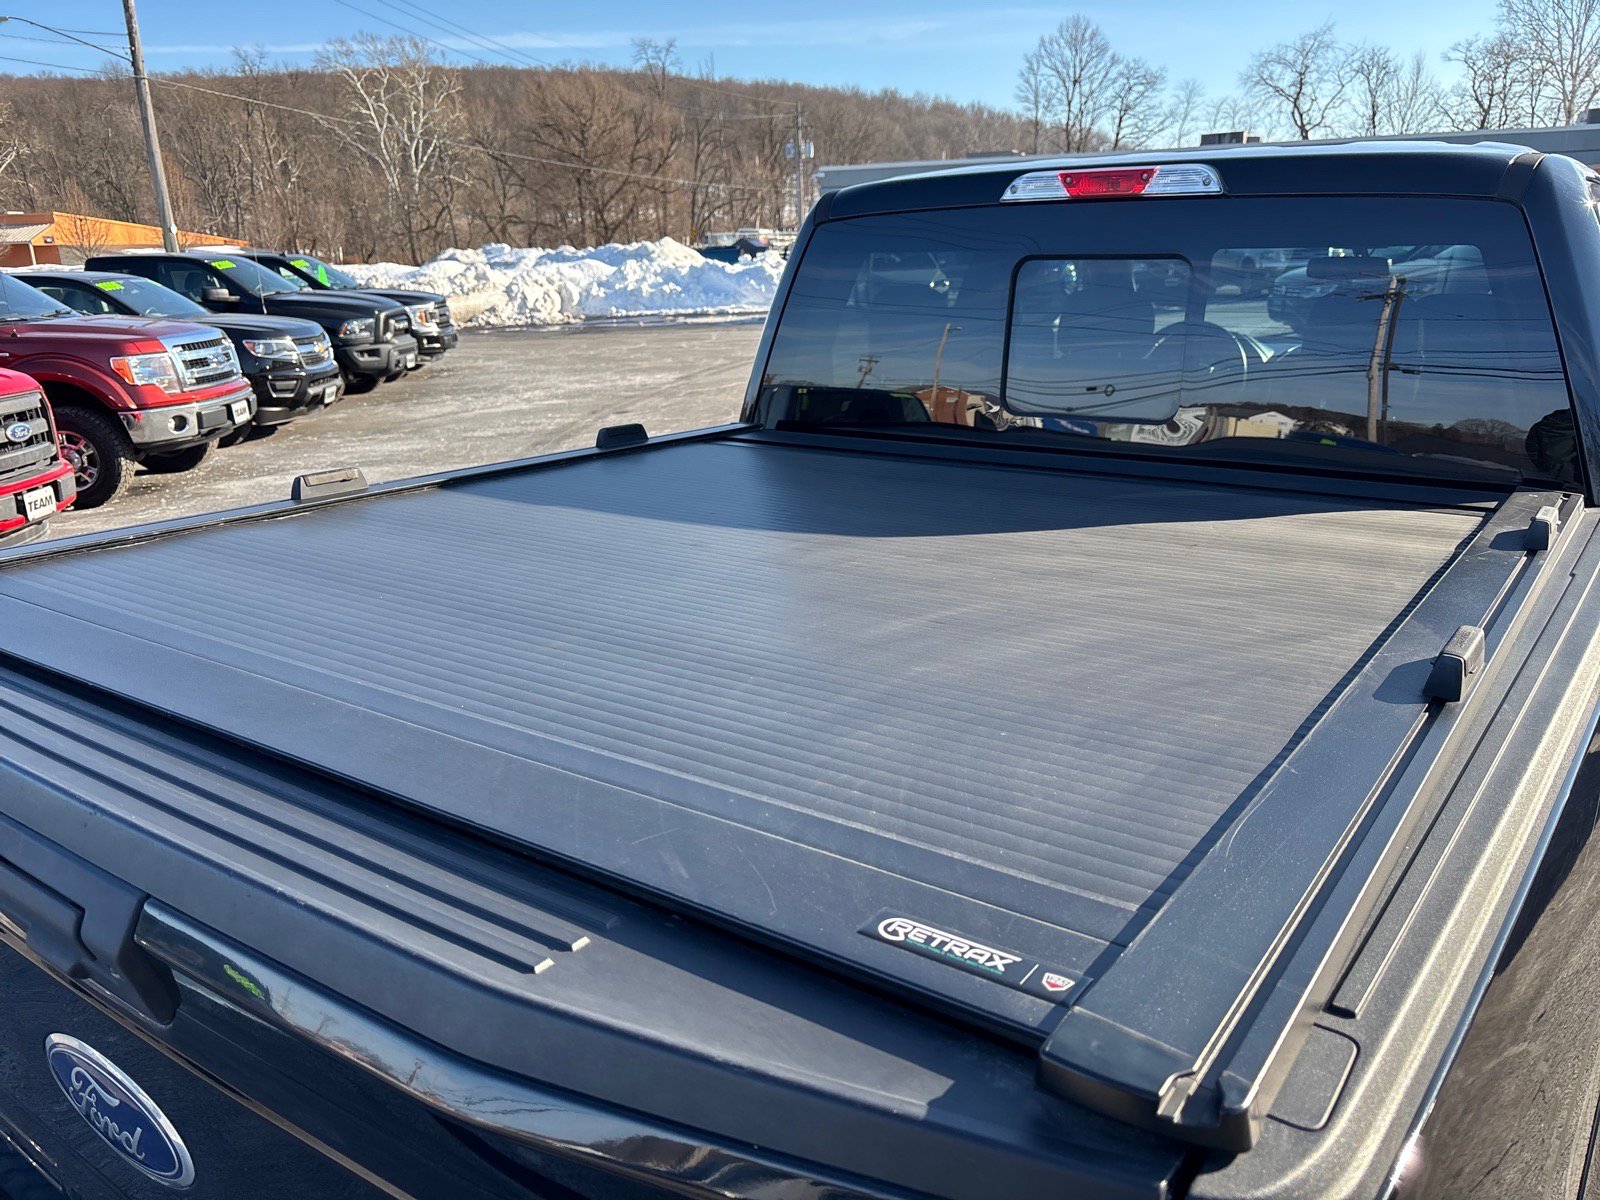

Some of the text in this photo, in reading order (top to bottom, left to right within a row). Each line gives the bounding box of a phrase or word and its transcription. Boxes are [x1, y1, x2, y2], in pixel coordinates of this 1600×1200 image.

[28, 495, 53, 512] TEAM
[878, 917, 1021, 972] RETRAX
[69, 1066, 146, 1160] Ford
